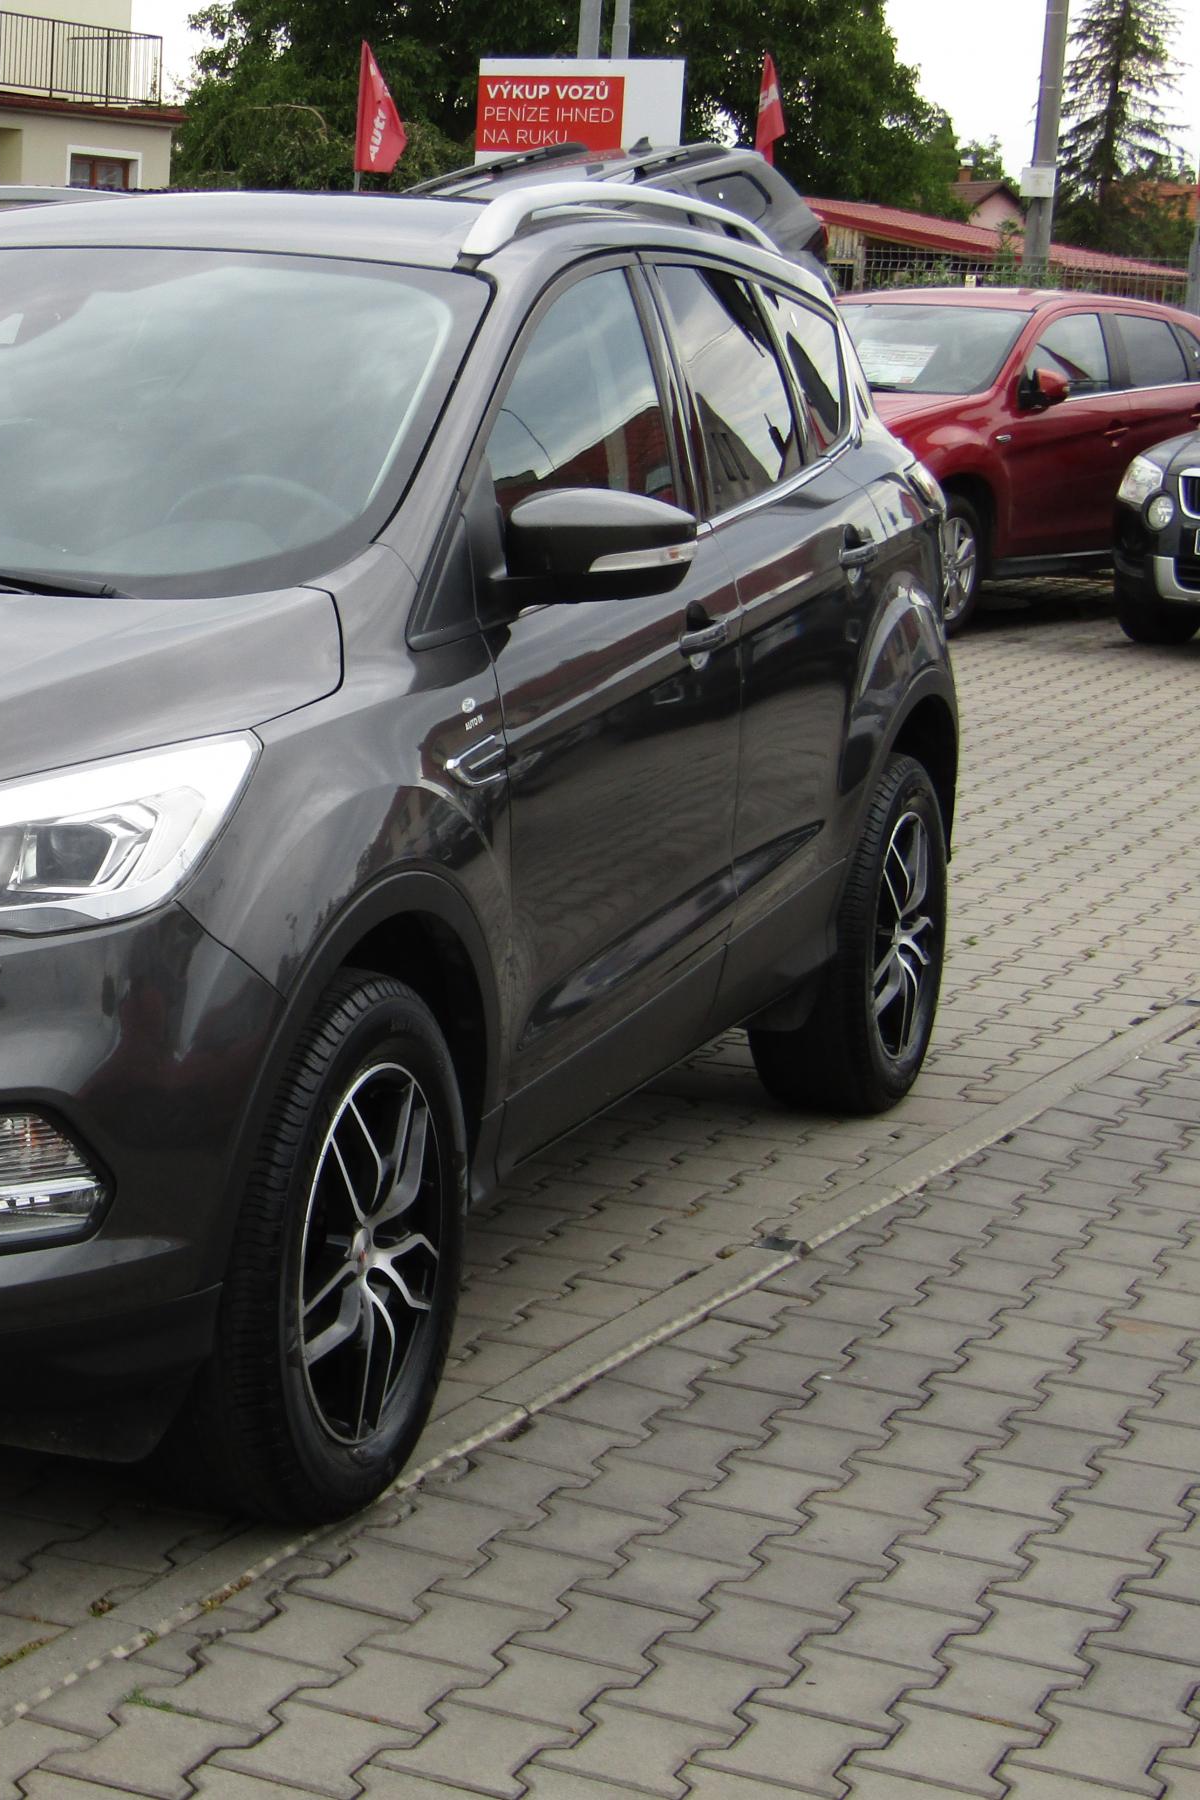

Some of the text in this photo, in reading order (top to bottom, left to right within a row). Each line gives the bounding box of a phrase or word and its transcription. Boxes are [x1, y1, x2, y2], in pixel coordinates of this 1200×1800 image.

[486, 80, 609, 100] VÝKUP VOZŮ
[484, 104, 615, 123] PENÍZE IHNED
[483, 129, 568, 145] NA RUKU
